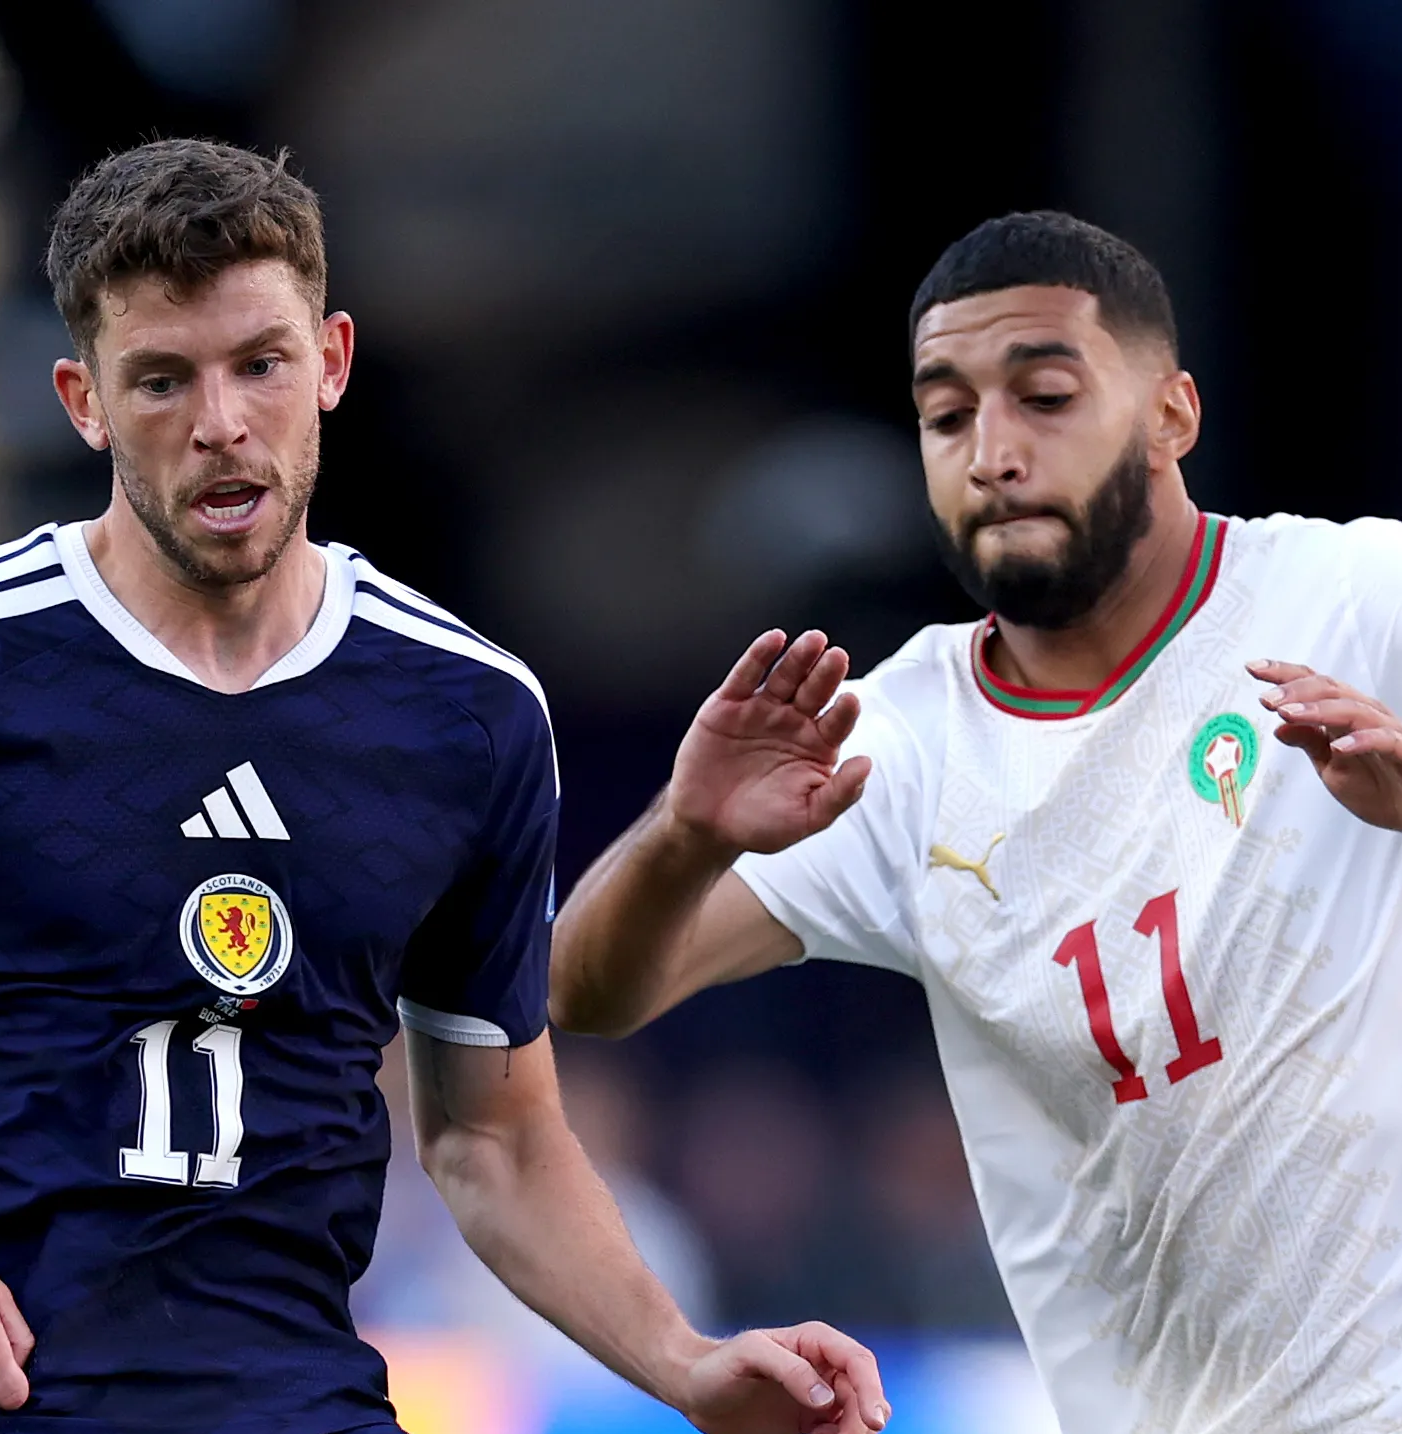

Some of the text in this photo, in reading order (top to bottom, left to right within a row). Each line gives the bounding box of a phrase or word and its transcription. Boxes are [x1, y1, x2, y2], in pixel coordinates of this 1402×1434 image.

[206, 876, 263, 892] SCOTLAND
[200, 965, 280, 985] EST 1873
[1053, 888, 1223, 1104] 11
[119, 1020, 244, 1189] 11
